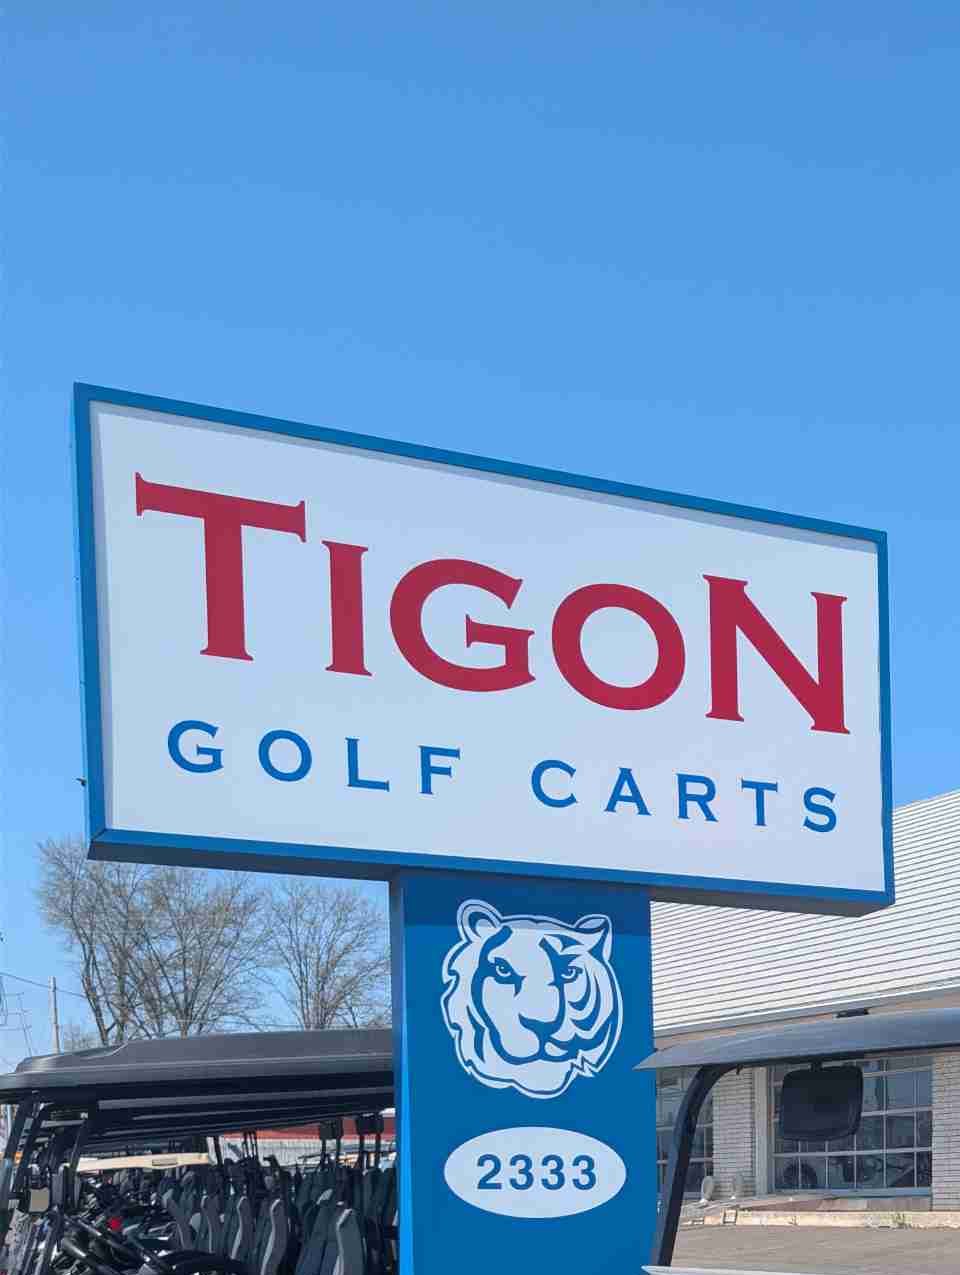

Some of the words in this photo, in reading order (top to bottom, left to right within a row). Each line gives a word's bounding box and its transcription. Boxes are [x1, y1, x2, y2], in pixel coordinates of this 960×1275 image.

[135, 472, 850, 734] TIGON
[167, 719, 461, 795] GOLF
[531, 759, 837, 832] CARTS
[477, 1154, 597, 1190] 2333
